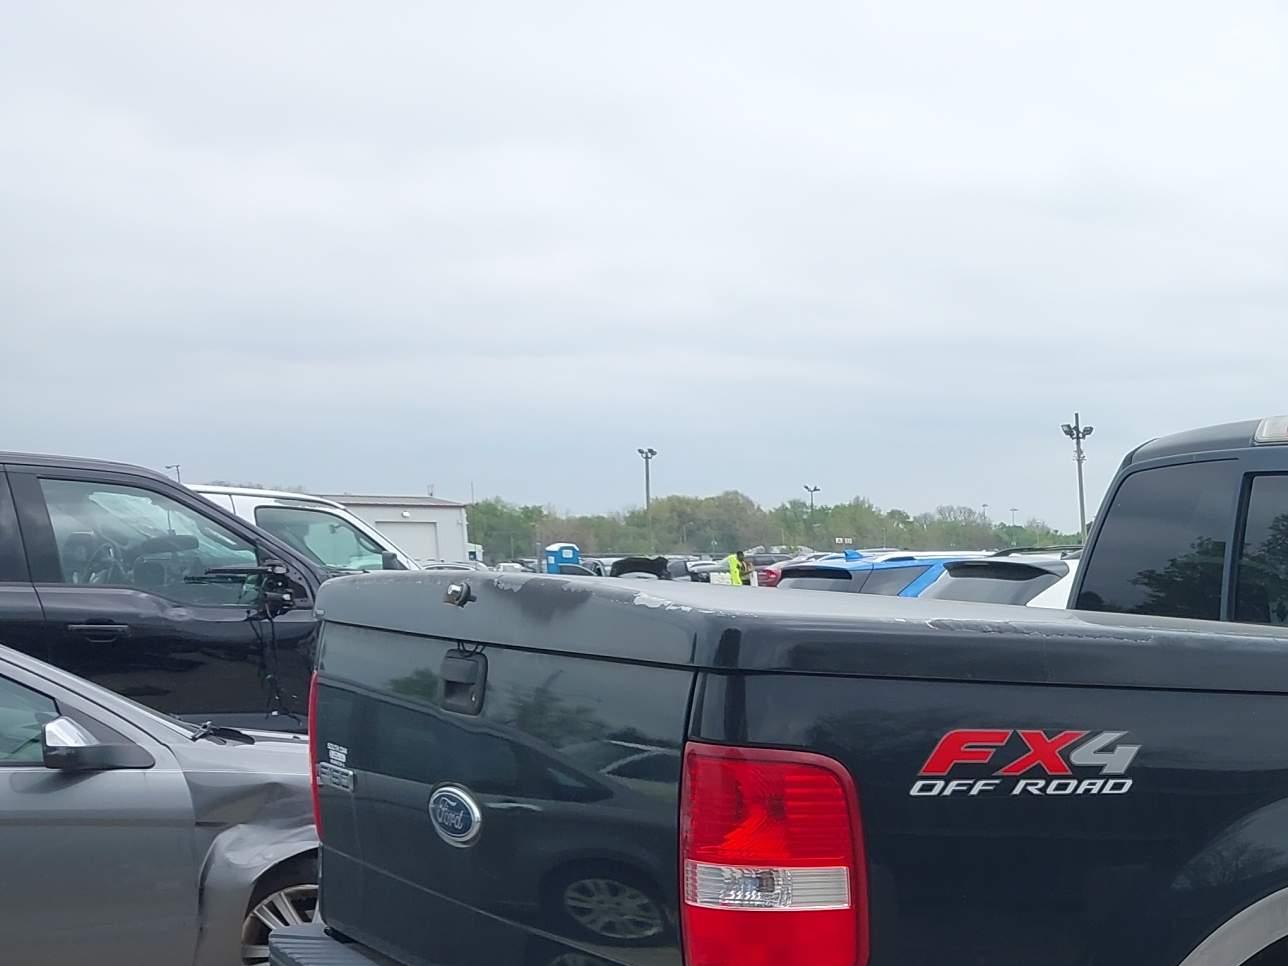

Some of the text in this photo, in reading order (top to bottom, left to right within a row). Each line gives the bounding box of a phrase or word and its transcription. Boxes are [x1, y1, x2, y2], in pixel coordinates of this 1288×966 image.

[917, 729, 1143, 776] FX4
[910, 779, 1134, 796] OFF ROAD
